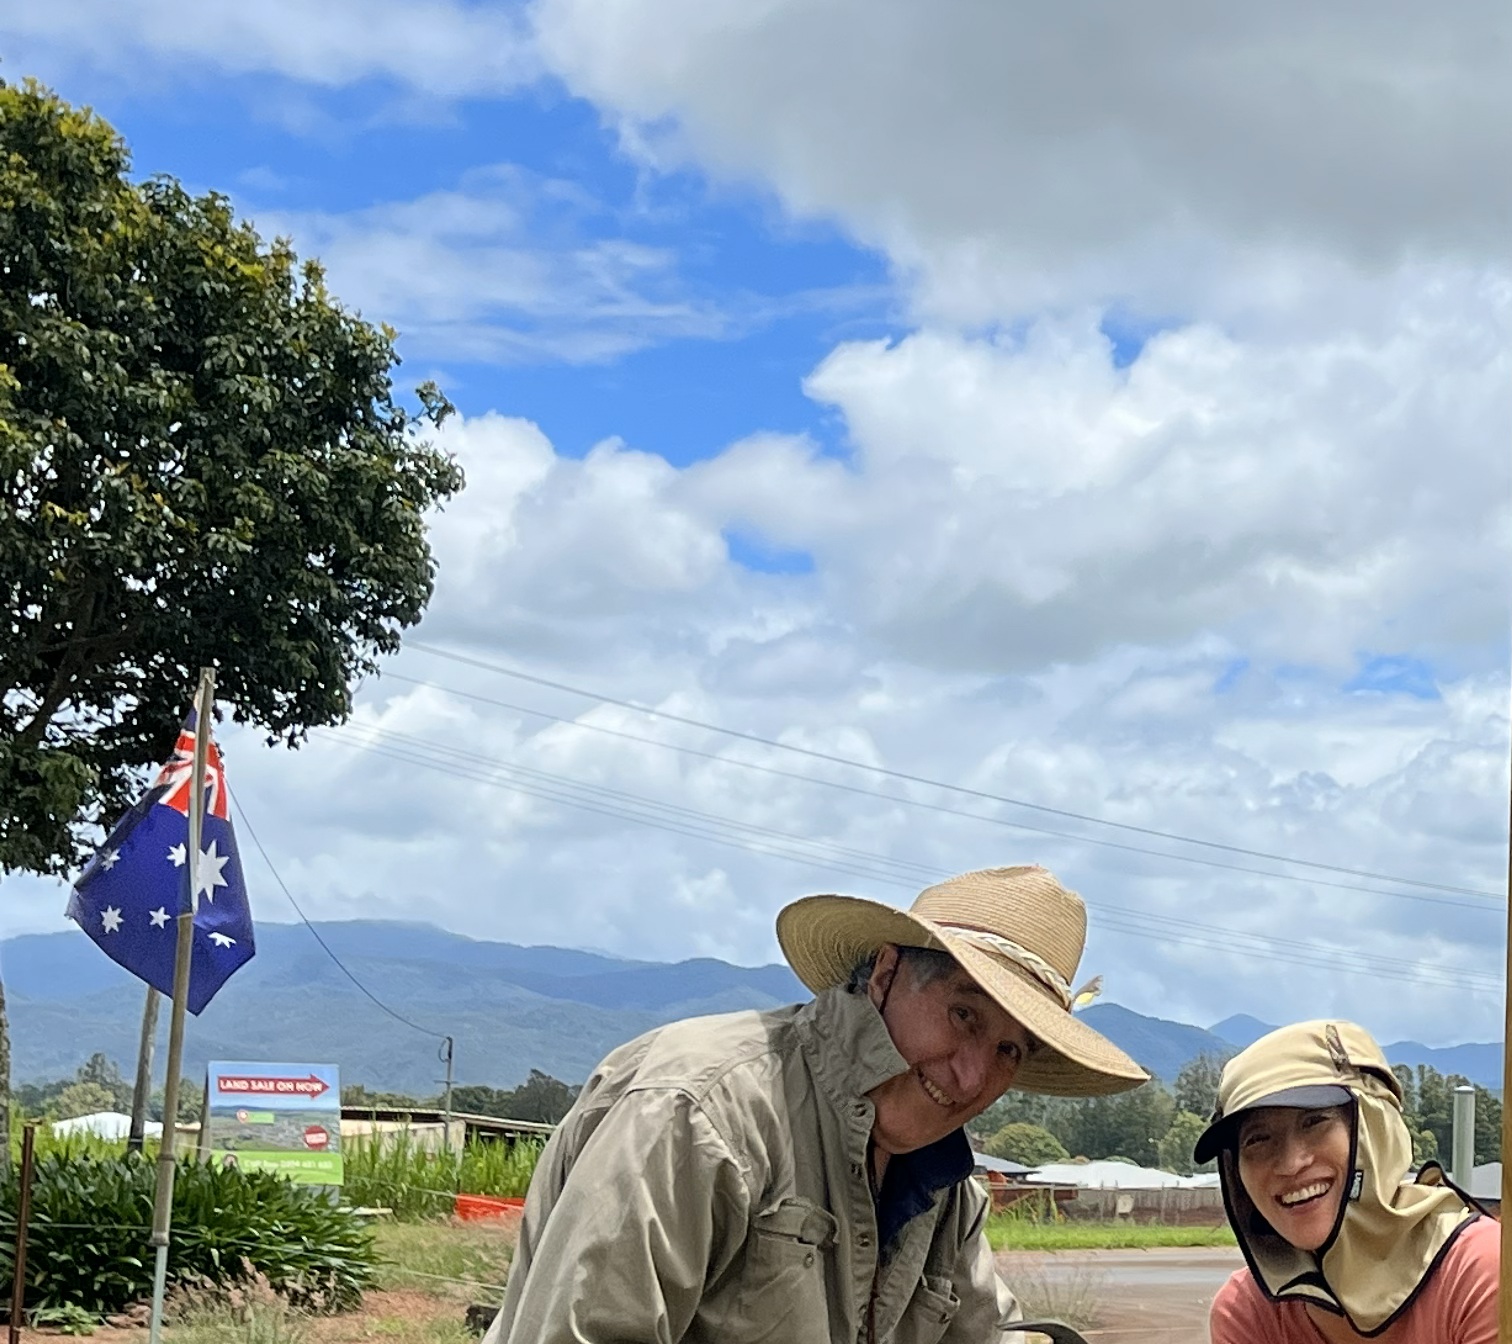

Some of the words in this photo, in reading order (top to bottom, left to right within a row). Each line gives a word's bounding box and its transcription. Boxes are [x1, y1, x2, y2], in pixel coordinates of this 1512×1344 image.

[220, 1079, 249, 1090] LAND
[250, 1080, 275, 1091] SALE
[276, 1081, 294, 1091] ON
[295, 1082, 323, 1092] NOW
